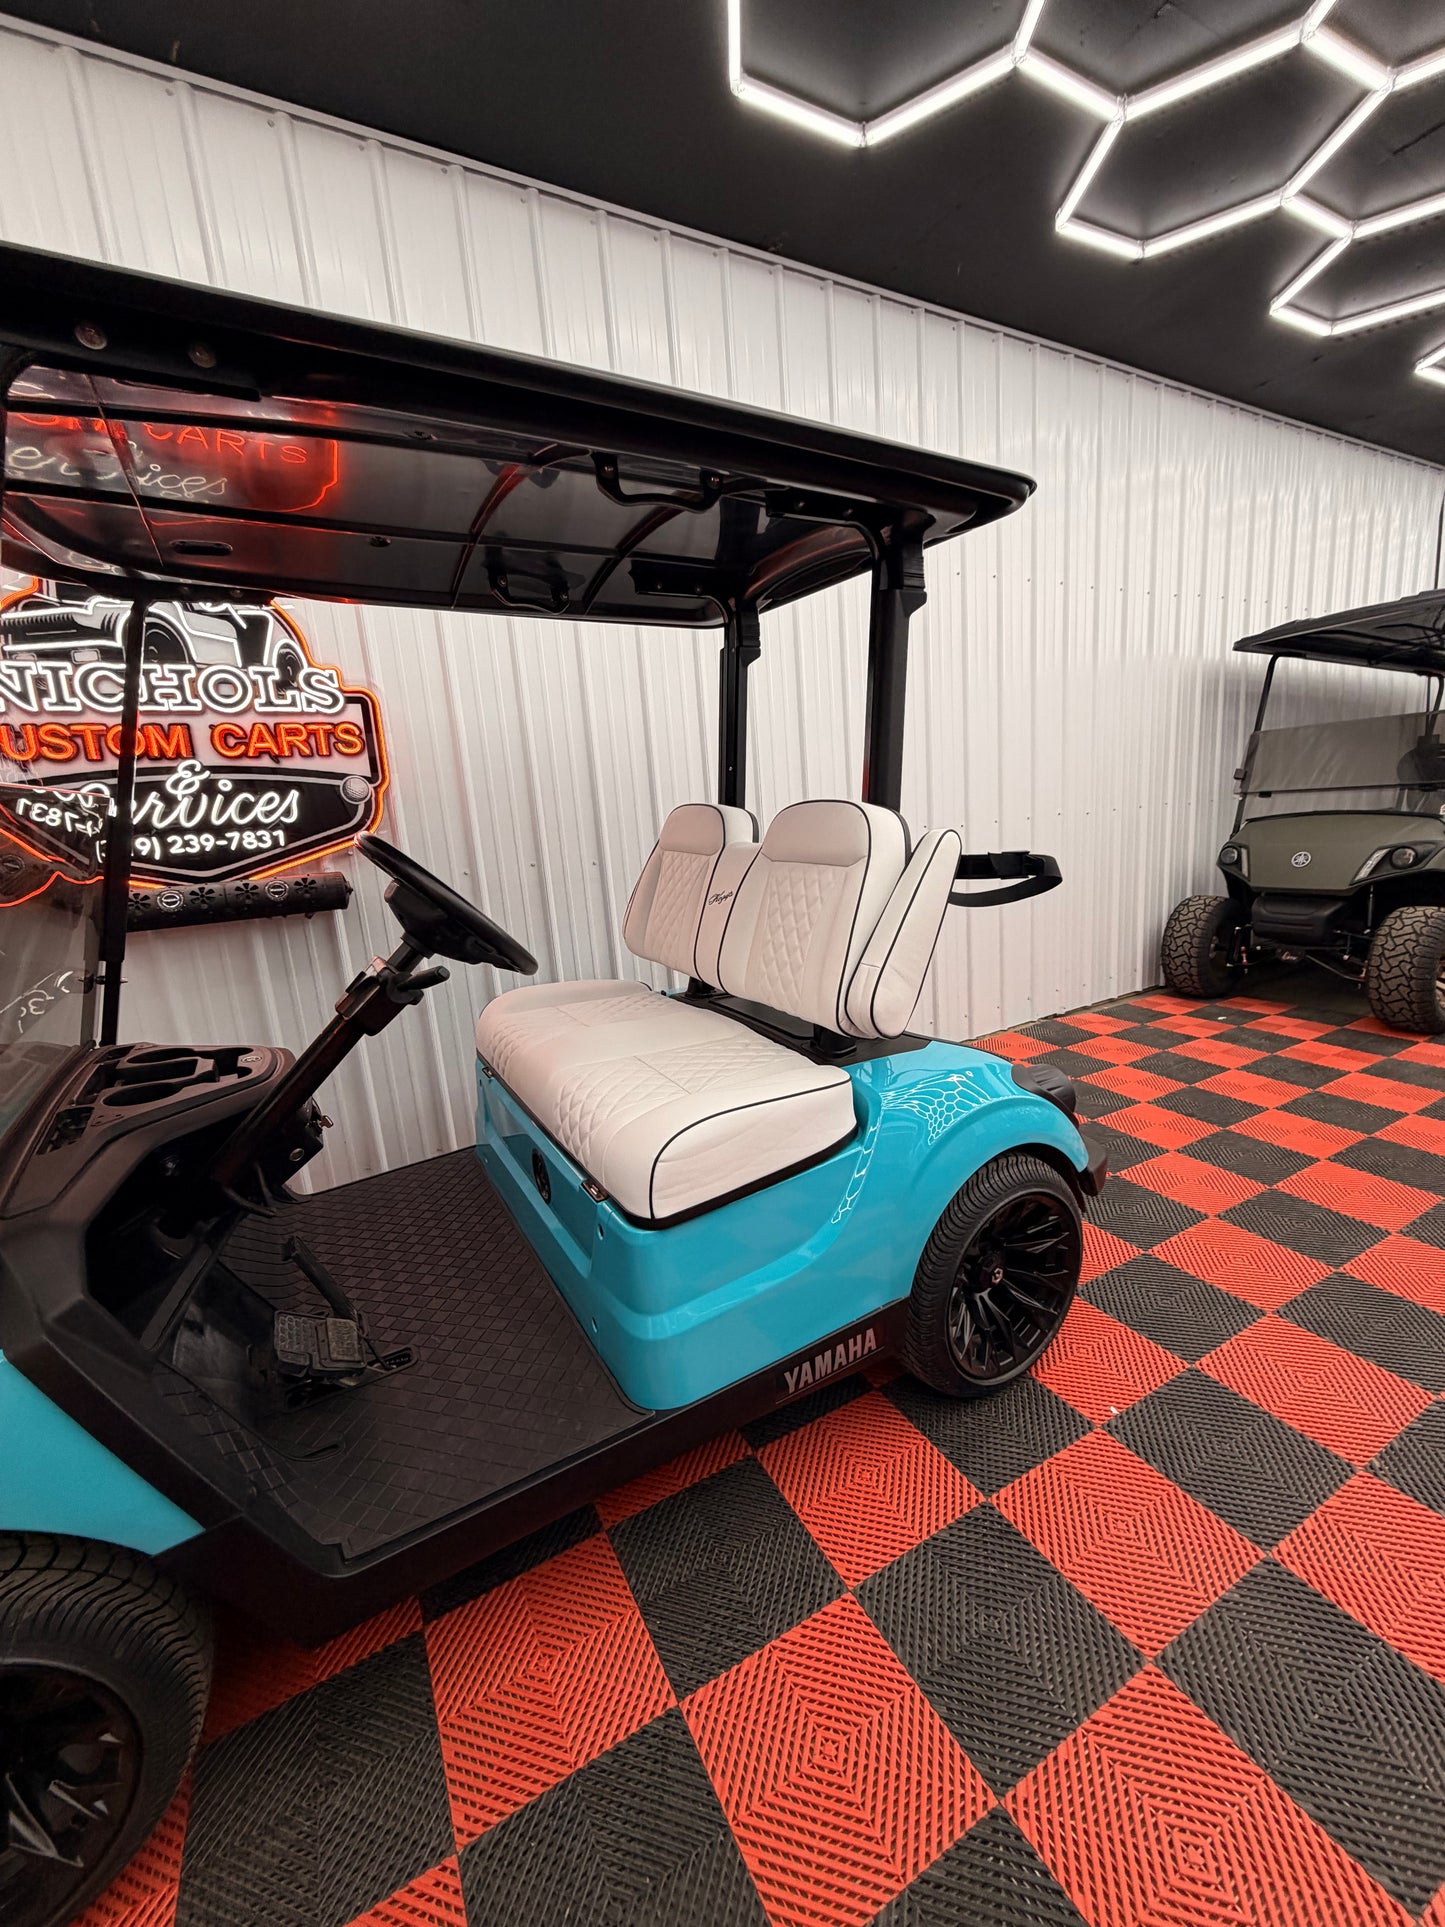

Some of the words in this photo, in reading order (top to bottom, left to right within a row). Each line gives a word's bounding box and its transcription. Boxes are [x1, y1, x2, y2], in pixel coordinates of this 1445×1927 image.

[0, 660, 345, 714] NICHOLS
[0, 722, 194, 763] USTOM
[211, 721, 365, 762] CARTS
[165, 759, 210, 800] &
[167, 829, 286, 854] 239-7831
[783, 1327, 877, 1394] YAMAHA
